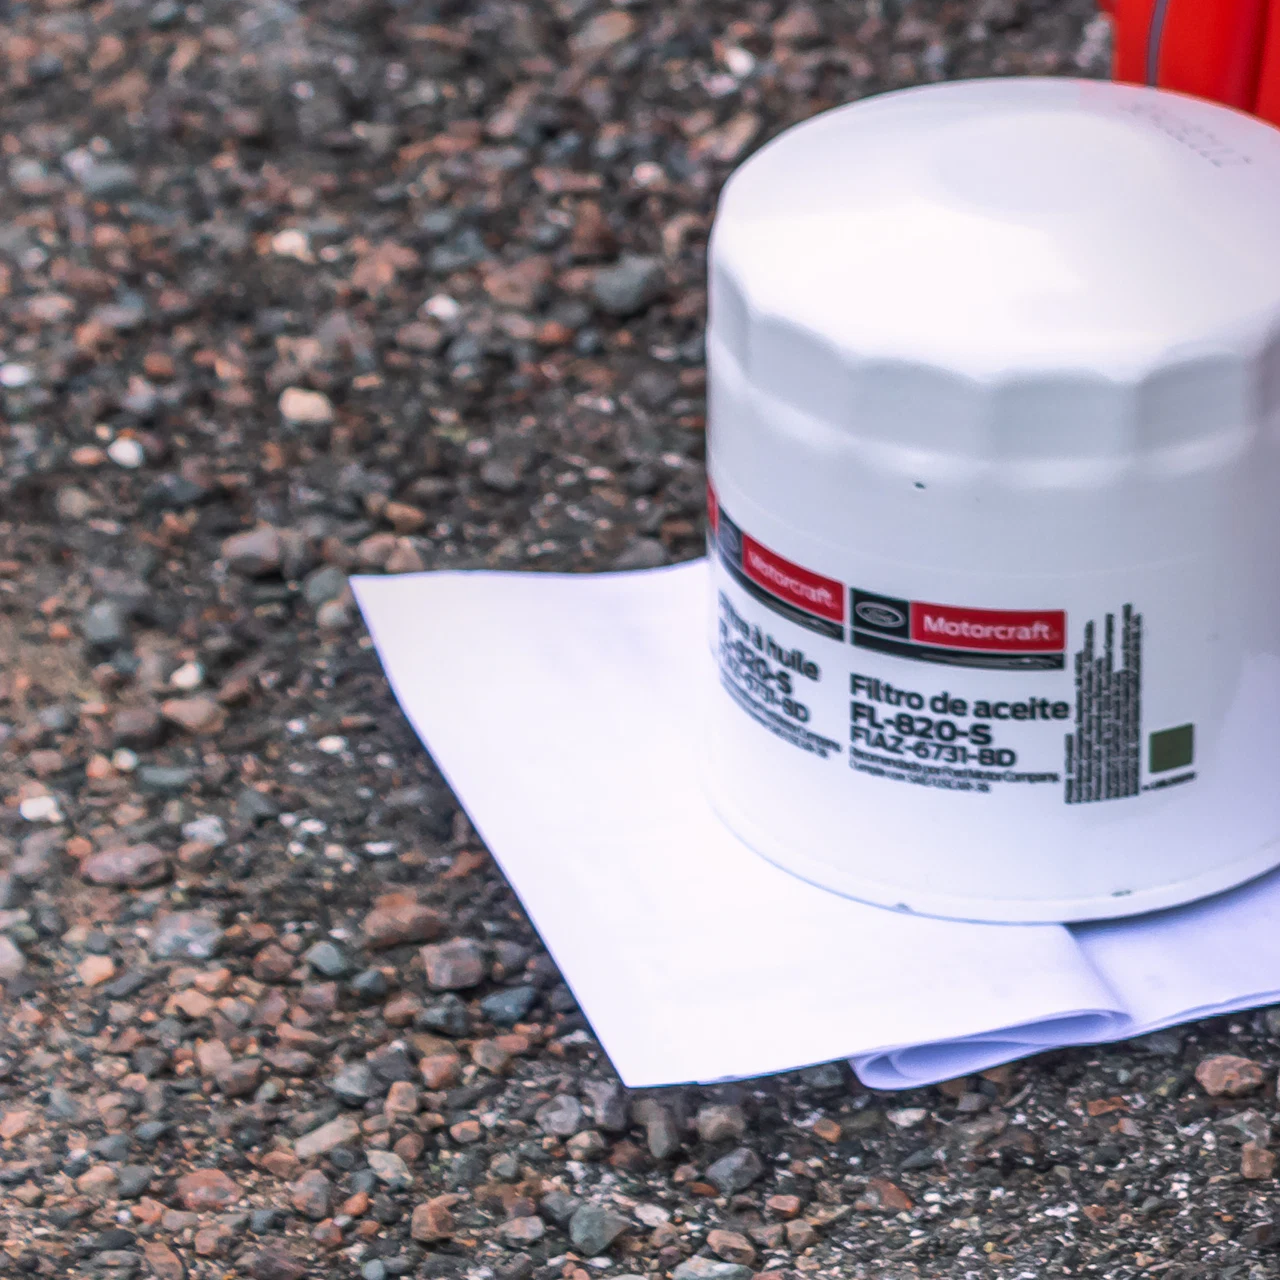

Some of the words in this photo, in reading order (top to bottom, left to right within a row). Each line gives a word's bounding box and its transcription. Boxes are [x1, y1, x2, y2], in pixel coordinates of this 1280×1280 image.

[923, 614, 1051, 641] Motorcraft
[766, 635, 821, 683] huile
[850, 672, 924, 711] Filtro
[929, 691, 968, 717] de
[973, 697, 1070, 720] aceite
[850, 700, 993, 746] FL-820-S
